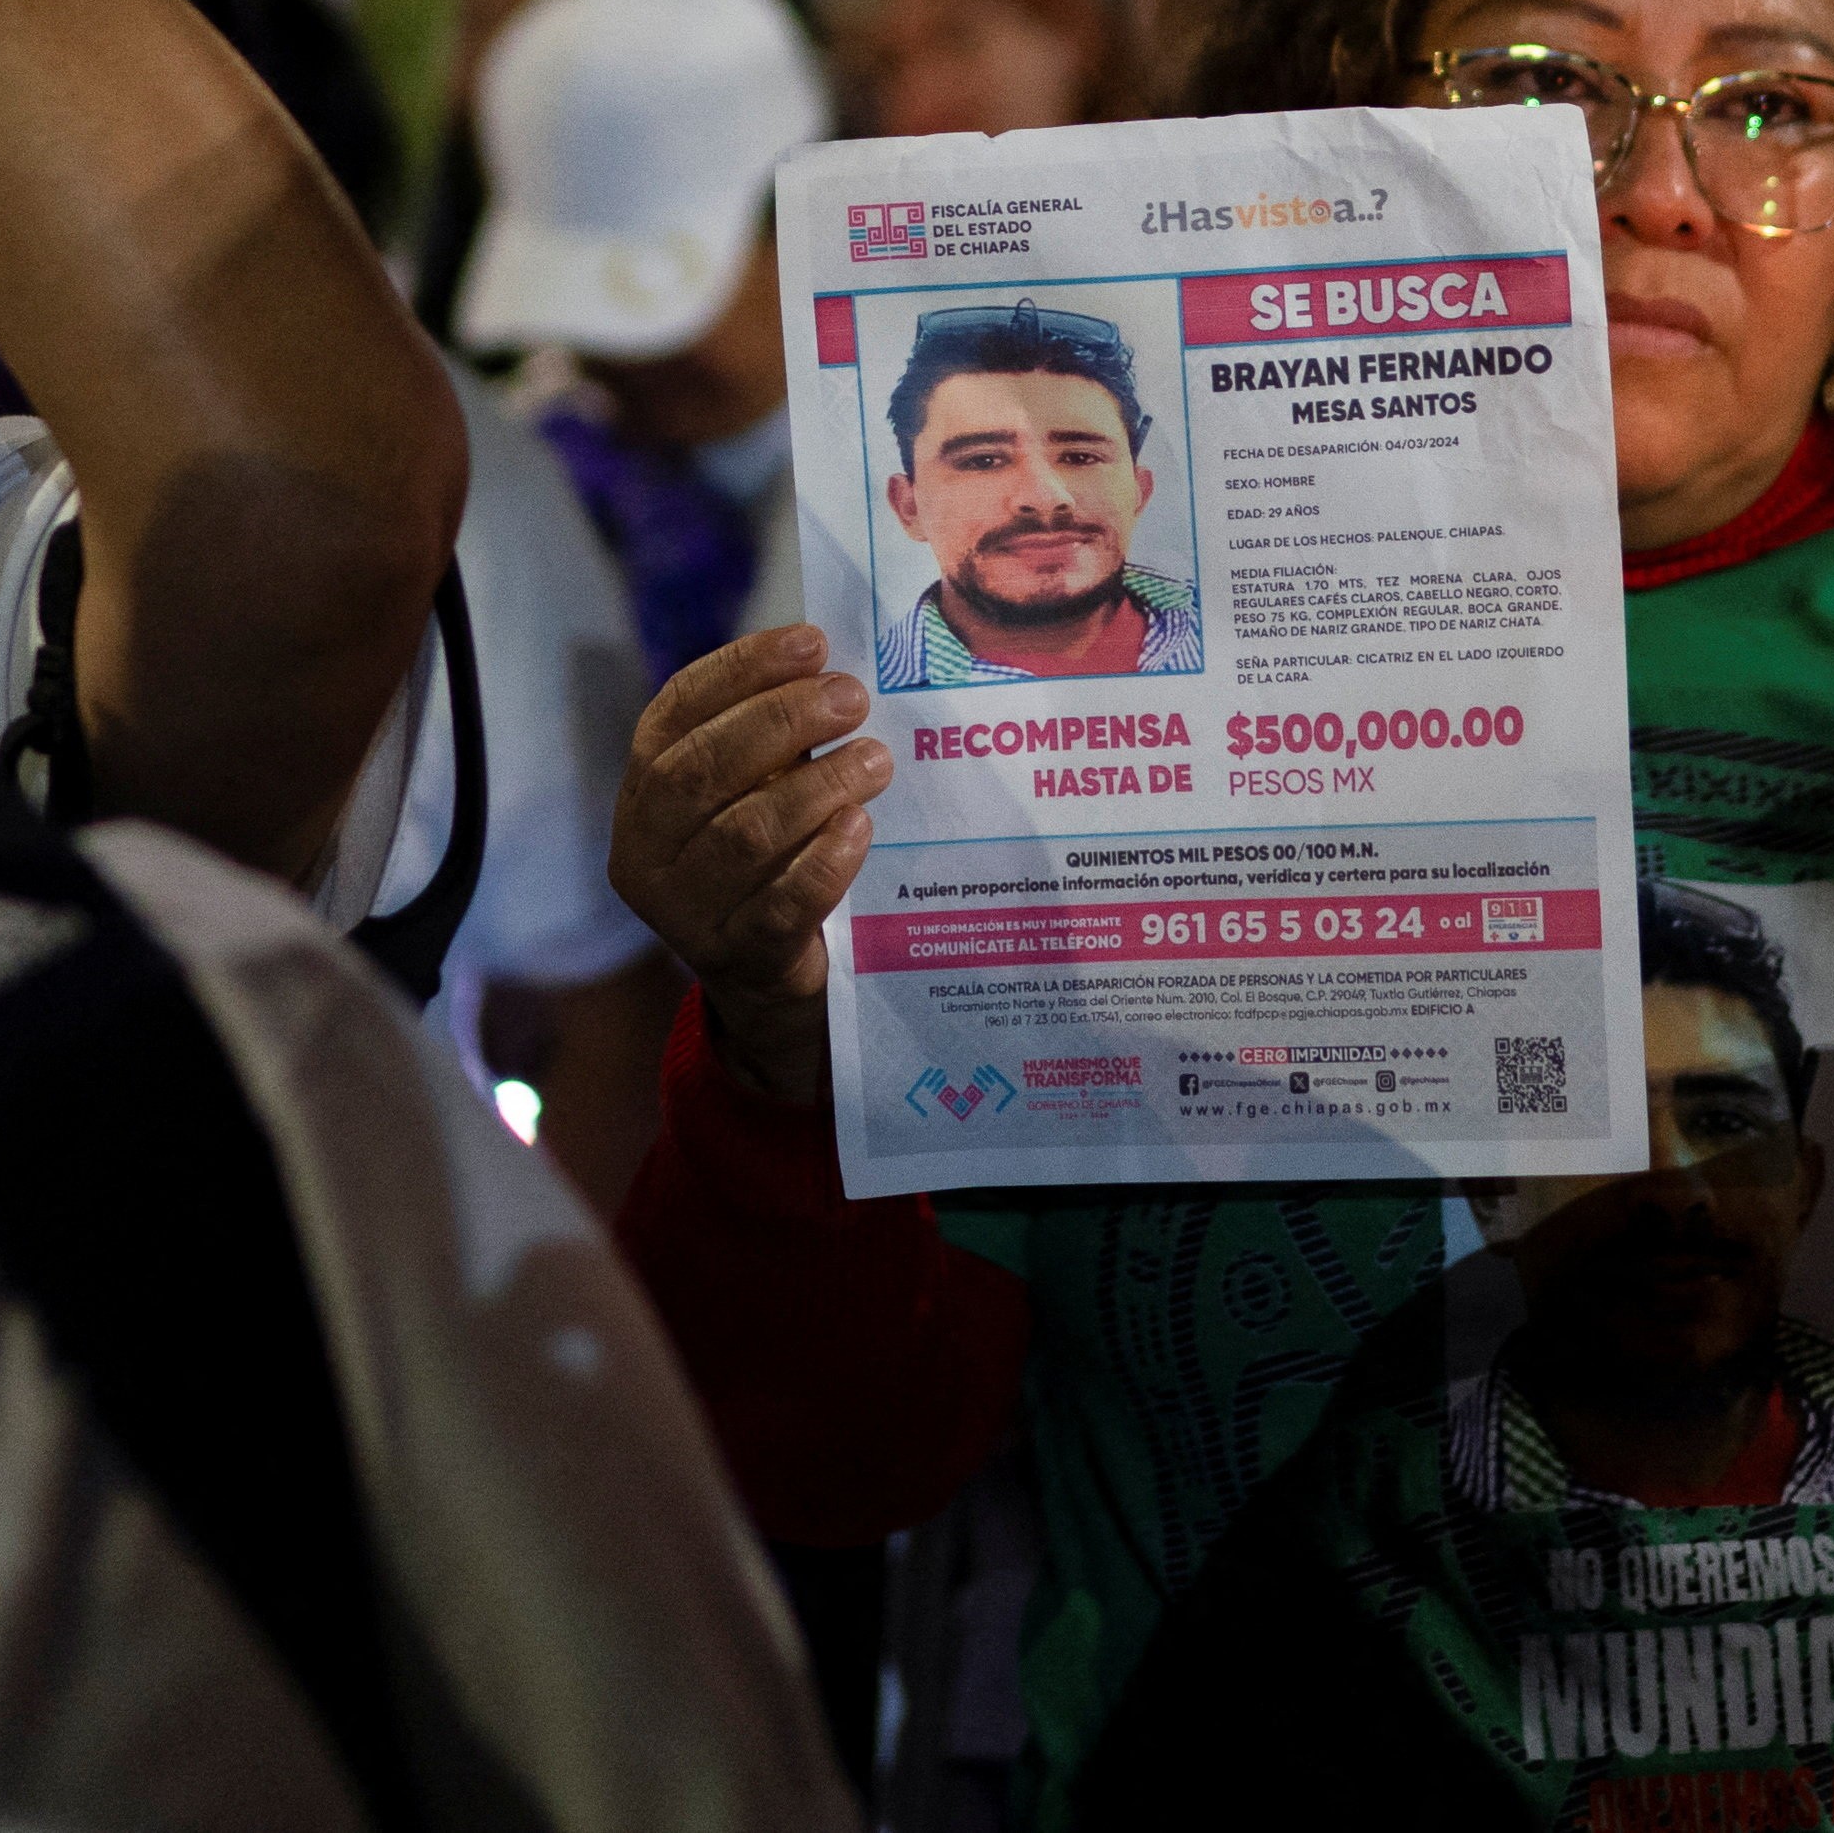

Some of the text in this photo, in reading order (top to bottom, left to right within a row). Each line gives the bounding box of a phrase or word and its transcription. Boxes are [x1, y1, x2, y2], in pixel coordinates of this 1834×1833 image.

[931, 198, 1082, 218] FISCALÍA GENERAL
[932, 220, 1031, 238] DEL ESTADO
[934, 240, 1029, 256] DE CHIAPAS
[1250, 270, 1507, 330] SE BUSCA
[1211, 344, 1552, 392] BRAYAN FERNANDO
[1292, 391, 1476, 424] MESA SANTOS
[1223, 447, 1264, 460] FECHA
[1267, 446, 1284, 459] DE
[1384, 436, 1459, 451] 04/03/2024
[1263, 475, 1314, 489] HOMBRE
[1268, 507, 1282, 518] 29
[1285, 503, 1319, 517] AÑOS
[1228, 537, 1270, 550] LUGAR
[1273, 536, 1289, 548] DE
[1293, 535, 1317, 547] LOS
[1230, 567, 1270, 580] MEDIA
[1231, 581, 1294, 595] ESTATURA
[1376, 575, 1399, 588] TEZ
[1409, 573, 1462, 586] MORENA
[1526, 569, 1561, 582] OJOS
[1232, 595, 1304, 609] REGULARES
[1307, 592, 1347, 606] CAFÉS
[1406, 588, 1463, 601] CABELLO
[1233, 612, 1266, 624] PESO
[1271, 611, 1285, 623] 75
[1315, 606, 1397, 621] COMPLEXIÓN
[1467, 601, 1502, 615] BOCA
[1235, 625, 1287, 639] TAMAÑO
[1290, 625, 1306, 637] DE
[1310, 624, 1347, 636] NARIZ
[1409, 620, 1436, 632] TIPO
[1439, 619, 1455, 630] DE
[1459, 618, 1496, 630] NARIZ
[1235, 655, 1268, 669] SEÑA
[1356, 651, 1412, 665] CICATRIZ
[1417, 651, 1434, 662] EN
[1438, 650, 1452, 661] EL
[1457, 648, 1491, 661] LADO
[1496, 646, 1564, 660] IZQUIERDO
[1237, 673, 1253, 685] DE
[1256, 673, 1272, 684] LA
[914, 712, 1189, 760] RECOMPENSA
[1227, 706, 1524, 756] $500,000.00
[1034, 764, 1191, 797] HASTA DE
[1228, 766, 1373, 797] PESOS MX
[1065, 848, 1174, 868] QUINIENTOS
[1178, 847, 1209, 863] MIL
[1212, 845, 1269, 862] PESOS
[1272, 843, 1336, 861] 00/100
[897, 884, 909, 899] A
[912, 881, 958, 901] quien
[961, 880, 1059, 898] proporcione
[1062, 873, 1159, 890] información
[1246, 868, 1311, 885] verídica
[1314, 871, 1324, 886] y
[1327, 867, 1385, 882] certera
[1389, 868, 1427, 883] para
[1431, 867, 1449, 880] su
[1452, 860, 1549, 879] localización
[906, 916, 1120, 937] TU INFORMACIÓN ES MUY IMPORTANTE
[1141, 906, 1471, 945] 961 65 5 03 24 o al
[909, 933, 1121, 958] COMUNÍCATE AL TELÉFONO
[928, 967, 1527, 998] FISCALÍA CONTRA LA DESAPARICIÓN FORZADA DE PERSONAS Y LA COMETIDA POR PARTICULARES
[1023, 1056, 1141, 1072] HUMANISMO QUE
[1290, 1045, 1386, 1063] IMPUNIDAD
[1023, 1071, 1143, 1087] TRANSFORMA
[1179, 1099, 1450, 1120] www.fge.chiapas.gob.mx
[1544, 1546, 1605, 1612] NO
